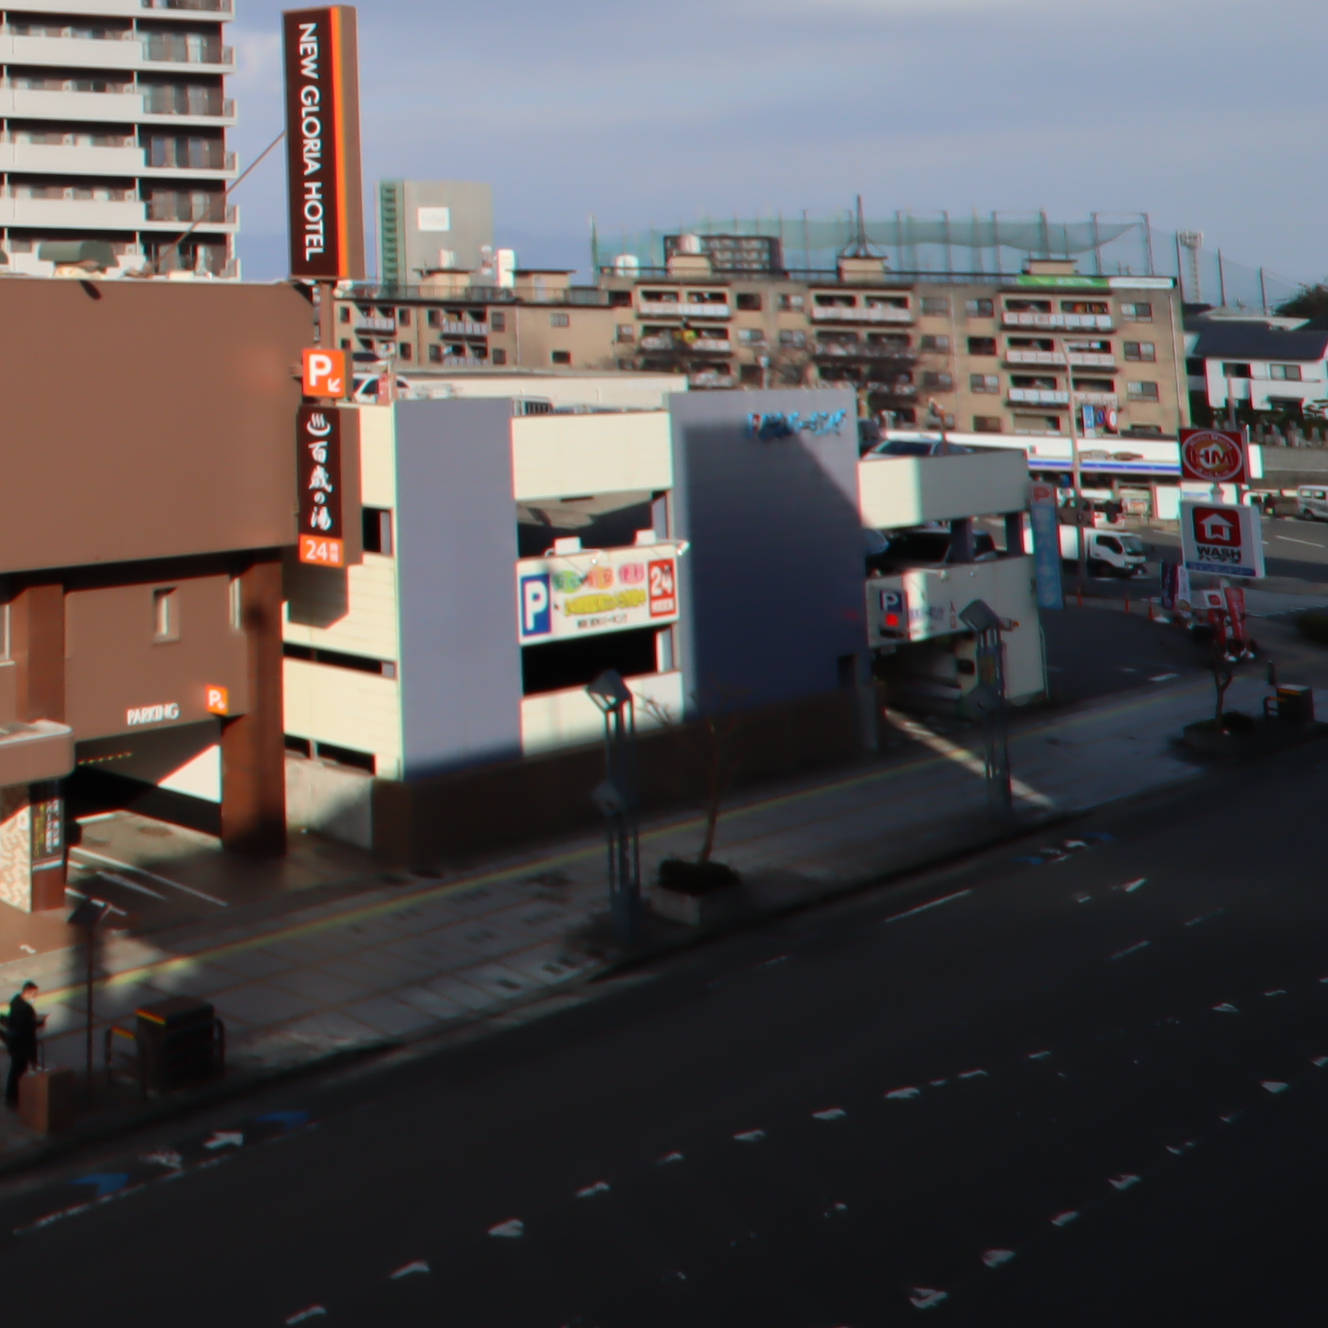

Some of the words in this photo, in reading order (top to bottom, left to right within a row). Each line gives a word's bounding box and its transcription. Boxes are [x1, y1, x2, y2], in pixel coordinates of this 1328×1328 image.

[299, 22, 319, 80] NEW
[301, 85, 322, 176] GLORIA
[303, 181, 325, 262] HOTEL
[308, 354, 332, 387] P
[308, 440, 333, 531] 百歳の湯
[1196, 545, 1242, 561] WASH
[523, 580, 549, 631] P
[881, 592, 899, 610] P
[127, 702, 180, 726] PARKING
[208, 689, 222, 707] P
